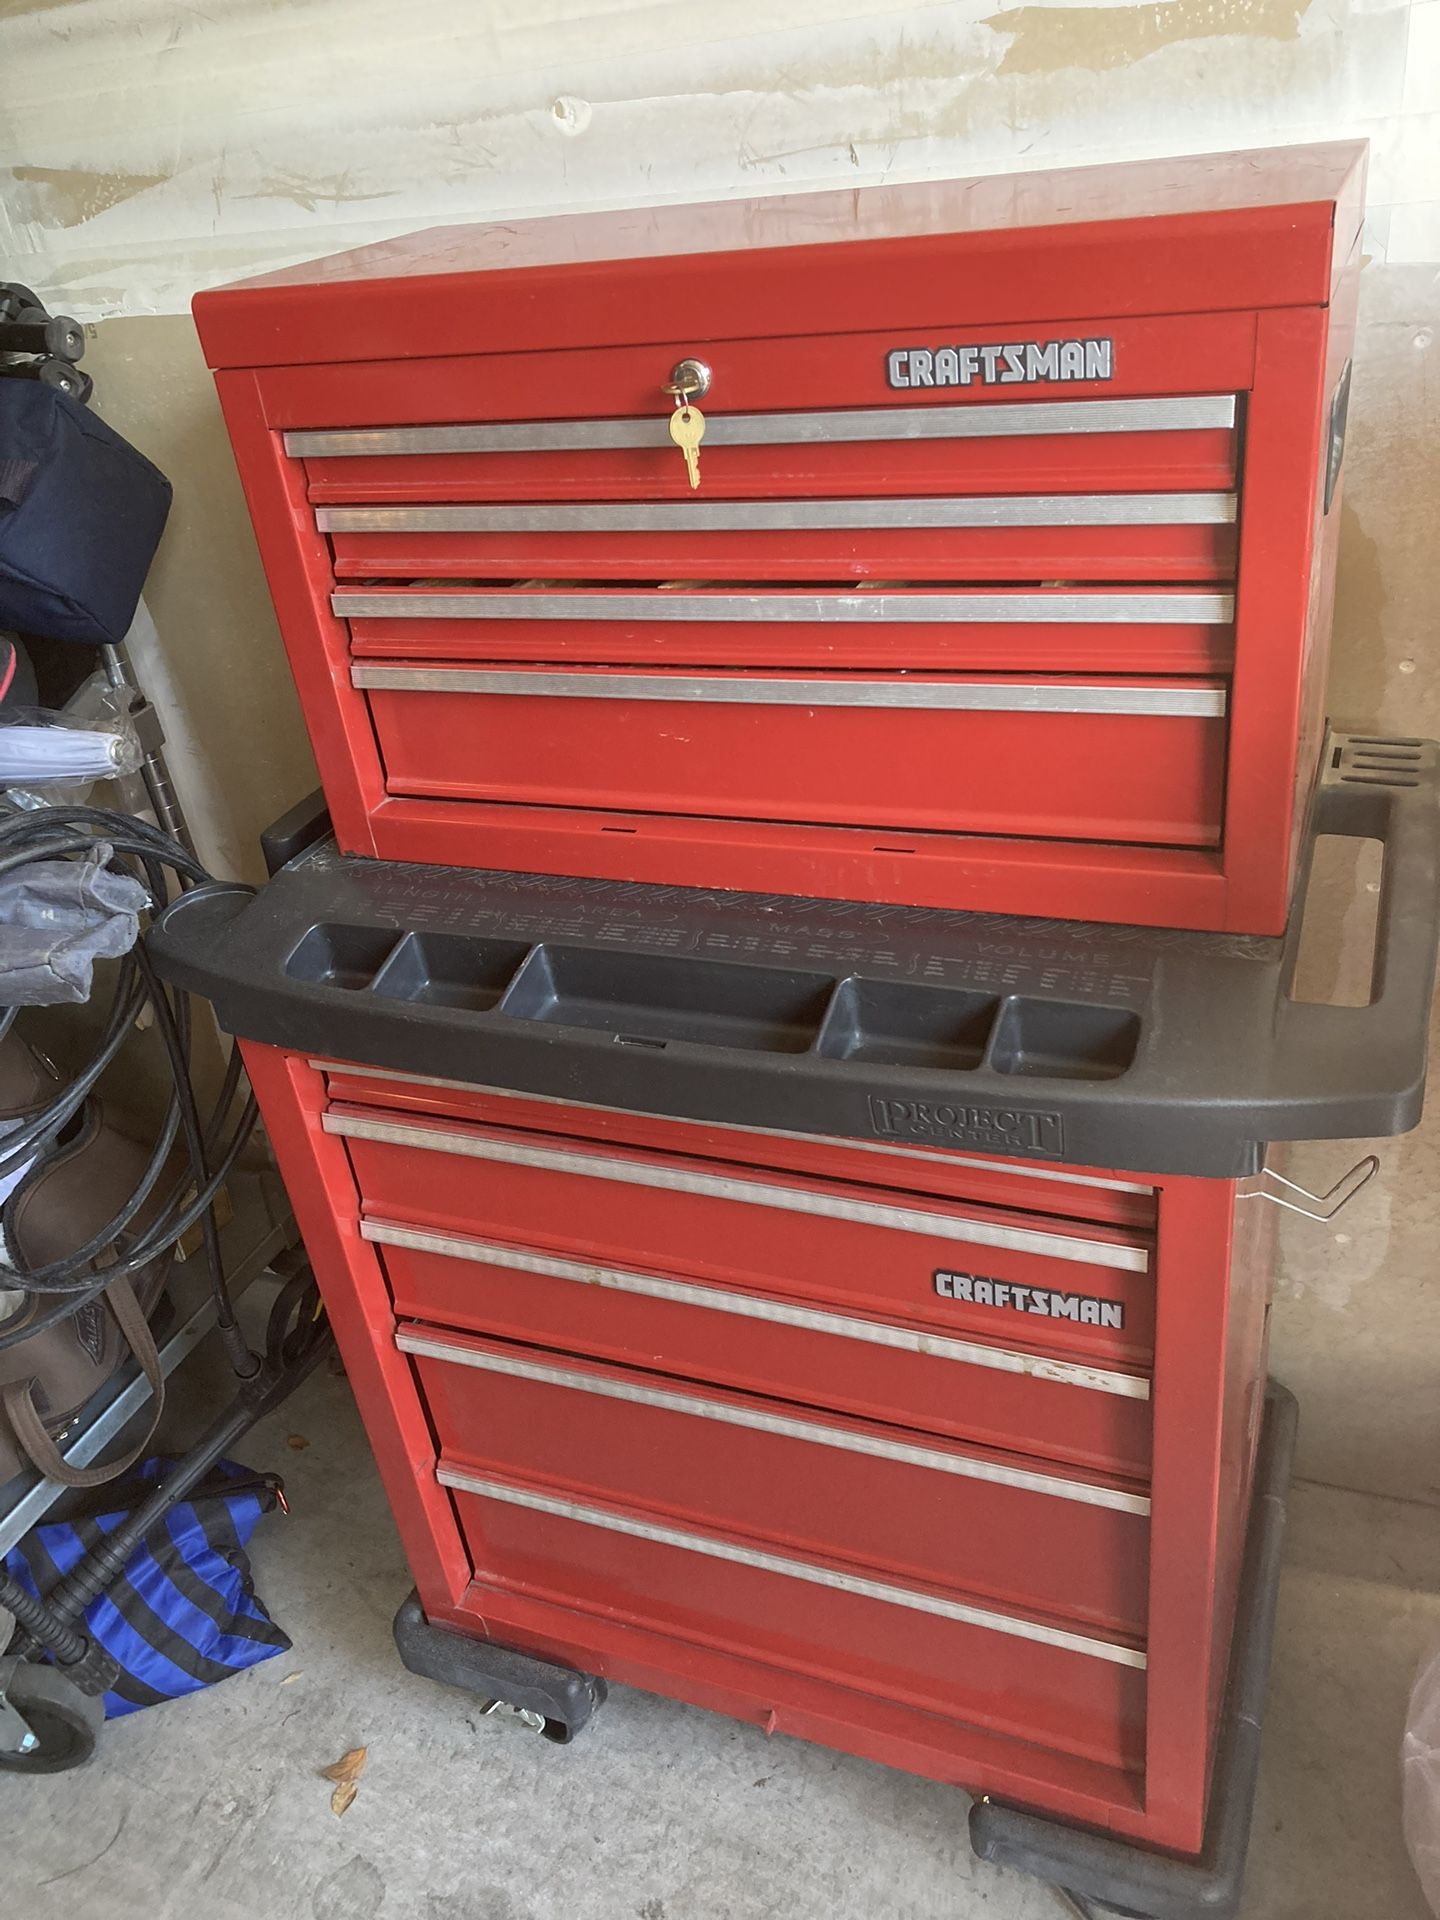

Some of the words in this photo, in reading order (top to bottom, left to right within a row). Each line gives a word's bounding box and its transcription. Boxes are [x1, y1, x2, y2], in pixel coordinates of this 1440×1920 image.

[887, 339, 1114, 389] CRAFTSMAN
[573, 904, 642, 918] AREA
[768, 922, 857, 939] MASS
[975, 942, 1113, 965] VOLUME
[876, 1098, 1056, 1152] PROJECT
[909, 1125, 1022, 1146] CENTER
[934, 1271, 1123, 1330] CRAFTSMAN
